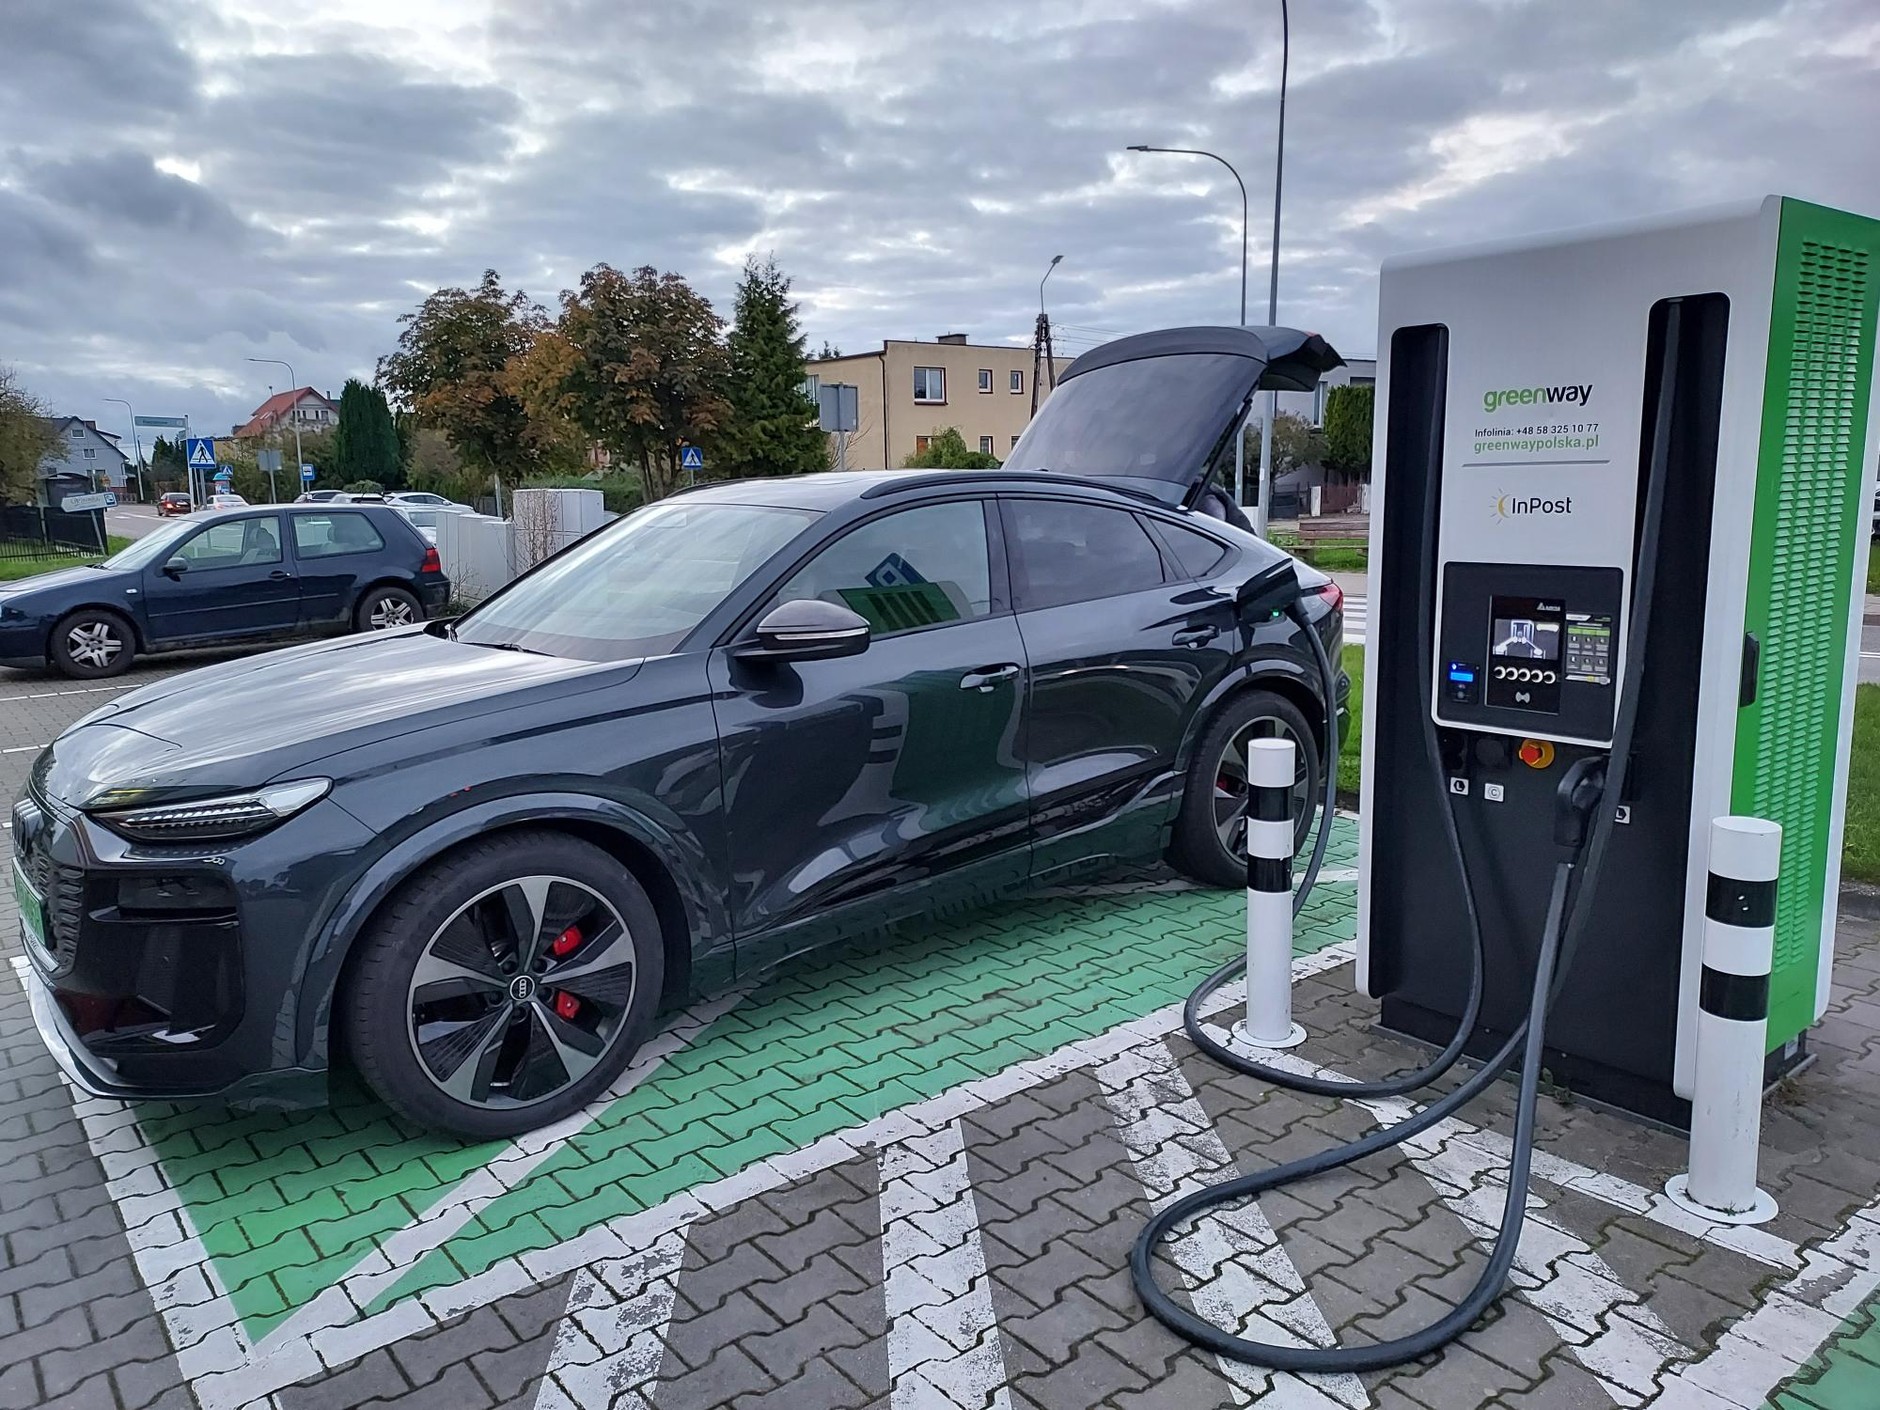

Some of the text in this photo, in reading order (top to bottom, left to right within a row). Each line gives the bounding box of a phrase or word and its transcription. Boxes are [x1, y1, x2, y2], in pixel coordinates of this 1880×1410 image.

[1483, 384, 1593, 413] greenway
[1474, 423, 1599, 438] Infolinia: +48 58 325 10 77
[1474, 435, 1599, 454] greenwaypolska.pl
[1512, 497, 1572, 514] InPost
